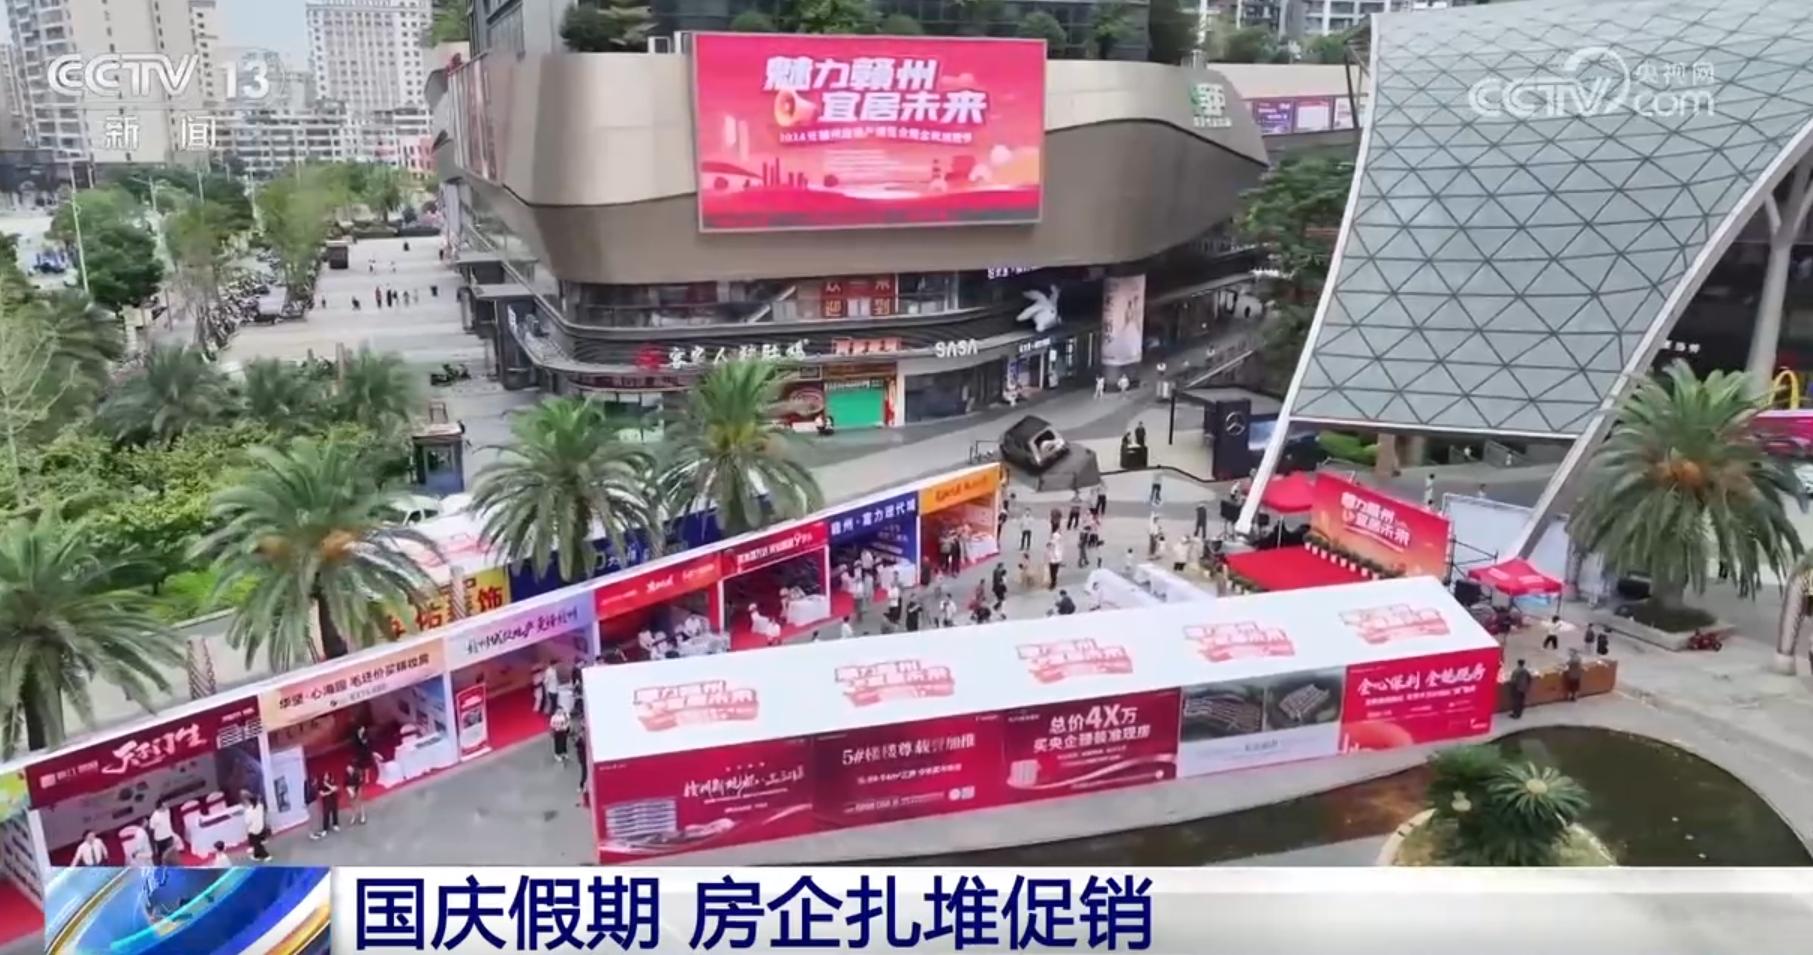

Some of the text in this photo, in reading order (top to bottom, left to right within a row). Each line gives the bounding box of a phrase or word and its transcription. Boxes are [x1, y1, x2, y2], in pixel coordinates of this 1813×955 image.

[764, 56, 938, 91] 魅力赣州
[818, 91, 987, 124] 宜居未来
[935, 338, 979, 359] SASA
[1049, 704, 1138, 734] 总价4X万
